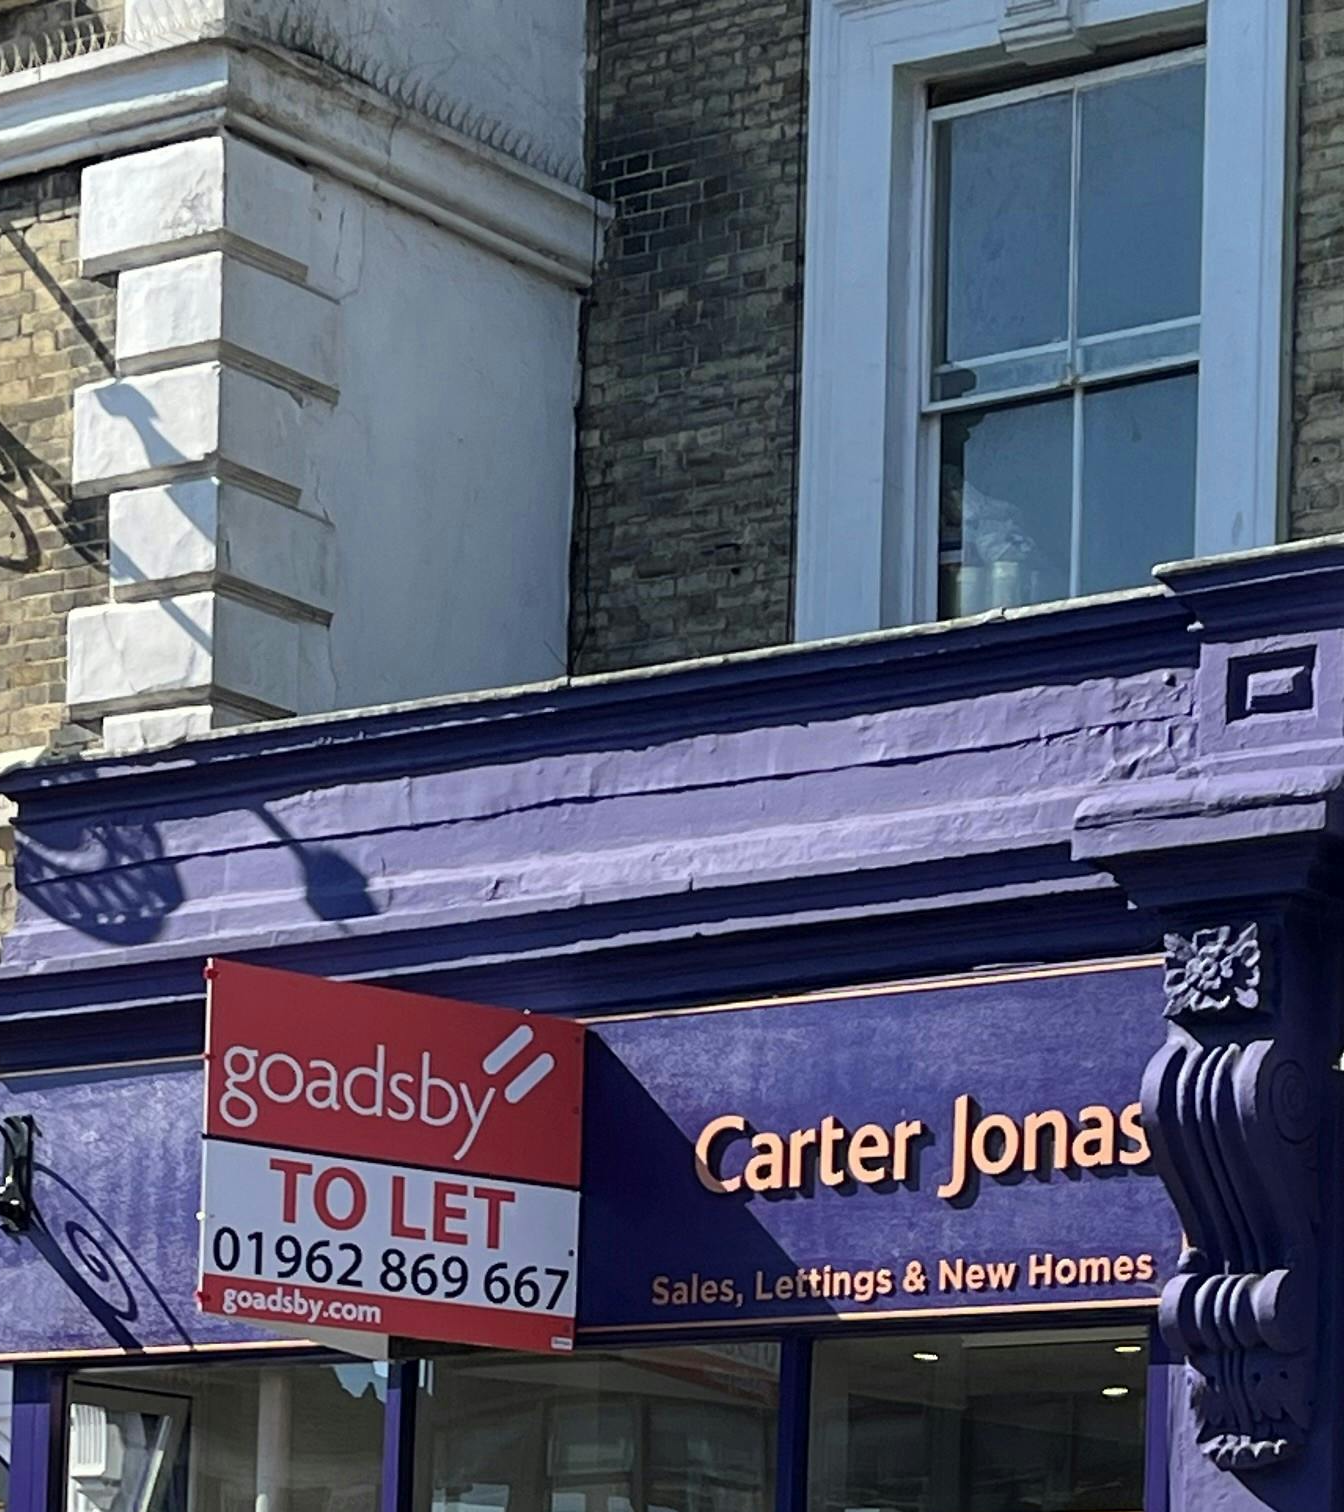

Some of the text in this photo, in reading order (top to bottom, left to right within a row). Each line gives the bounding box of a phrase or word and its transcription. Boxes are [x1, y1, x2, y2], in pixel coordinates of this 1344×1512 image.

[219, 1044, 496, 1161] goadsby
[694, 1094, 1153, 1199] Carter Jonas
[269, 1158, 516, 1250] TO LET
[213, 1225, 570, 1311] 01962 869 667
[222, 1286, 382, 1324] goadsby.com
[651, 1252, 1154, 1308] Sales, Lettings & New Homes
